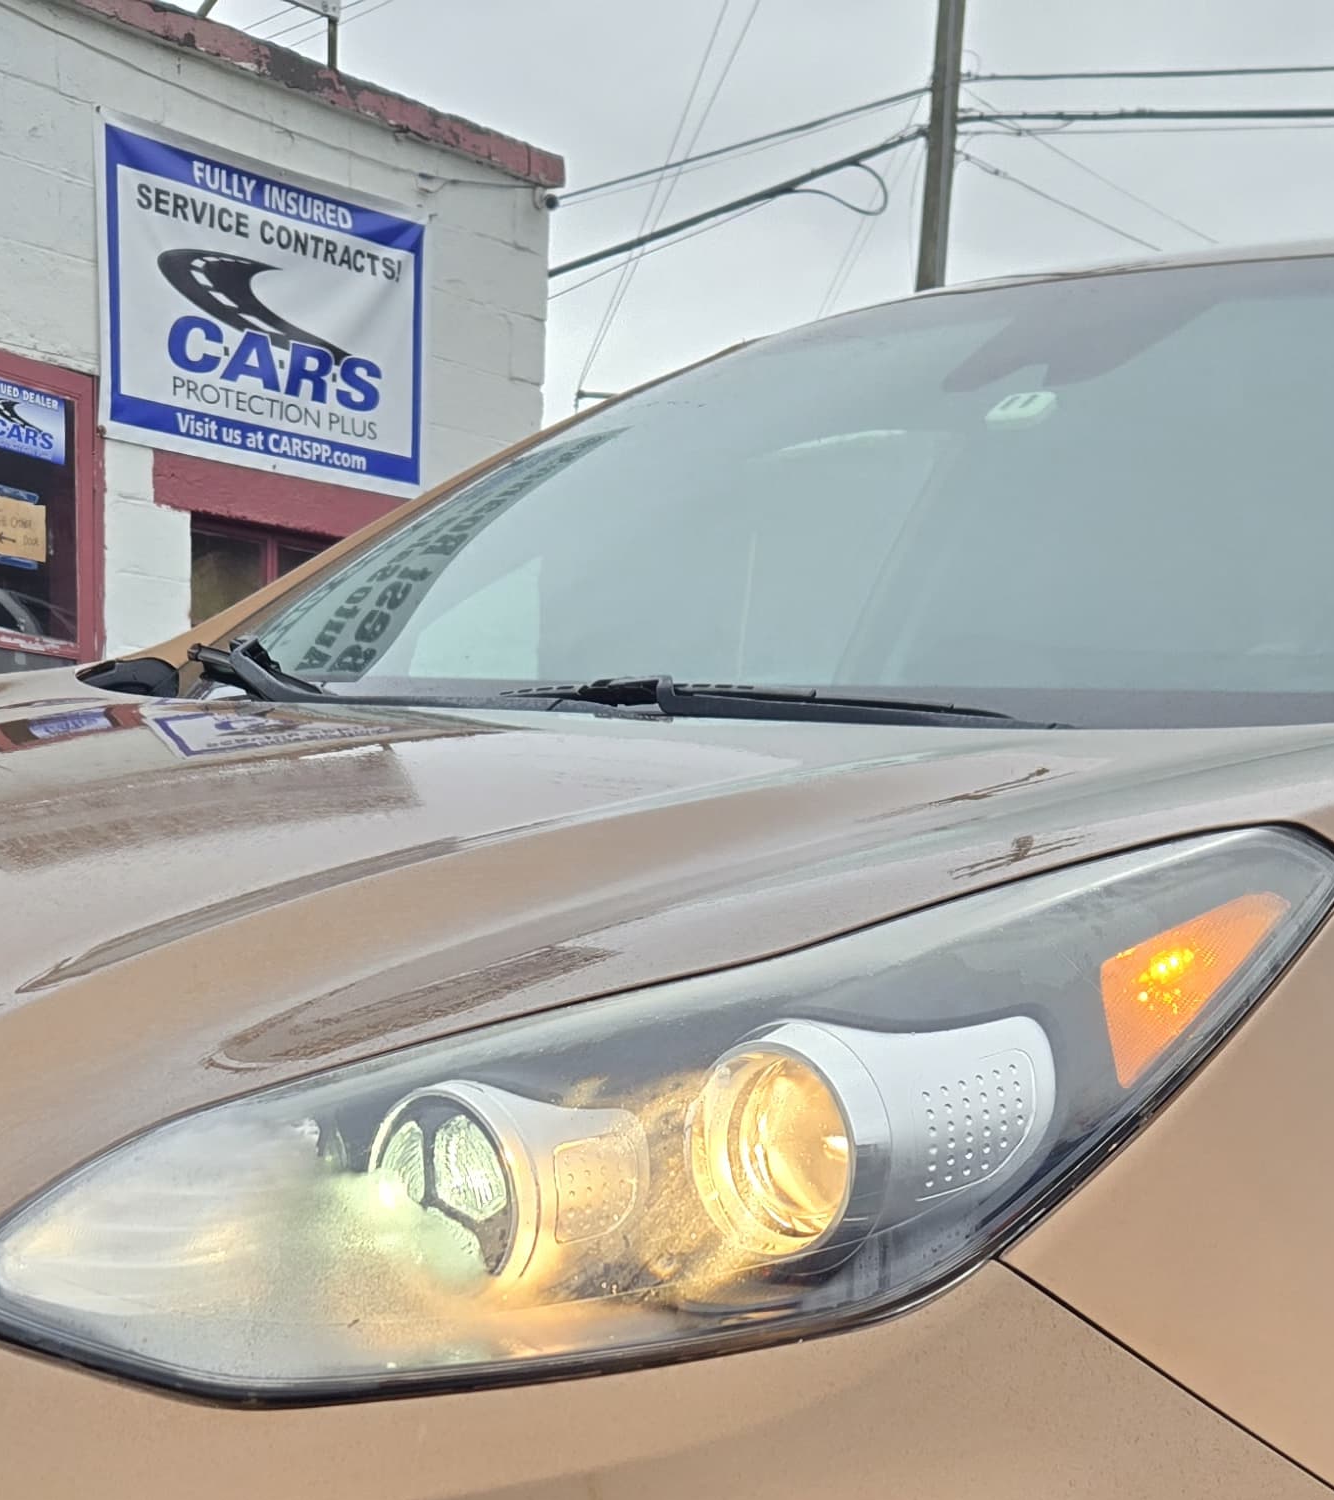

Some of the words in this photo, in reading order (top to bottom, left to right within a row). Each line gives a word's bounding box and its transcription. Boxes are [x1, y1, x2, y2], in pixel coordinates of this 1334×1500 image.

[192, 160, 257, 203] FULLY
[263, 183, 353, 230] INSURED
[136, 183, 250, 239] SERVICE
[259, 220, 403, 283] CONTRACTS!
[22, 389, 59, 411] DEALER
[172, 376, 322, 430] PROTECTION
[327, 412, 379, 441] PLUS
[176, 412, 218, 441] Visit
[222, 425, 243, 446] us
[247, 431, 265, 451] at
[267, 433, 368, 472] CARSPP.com
